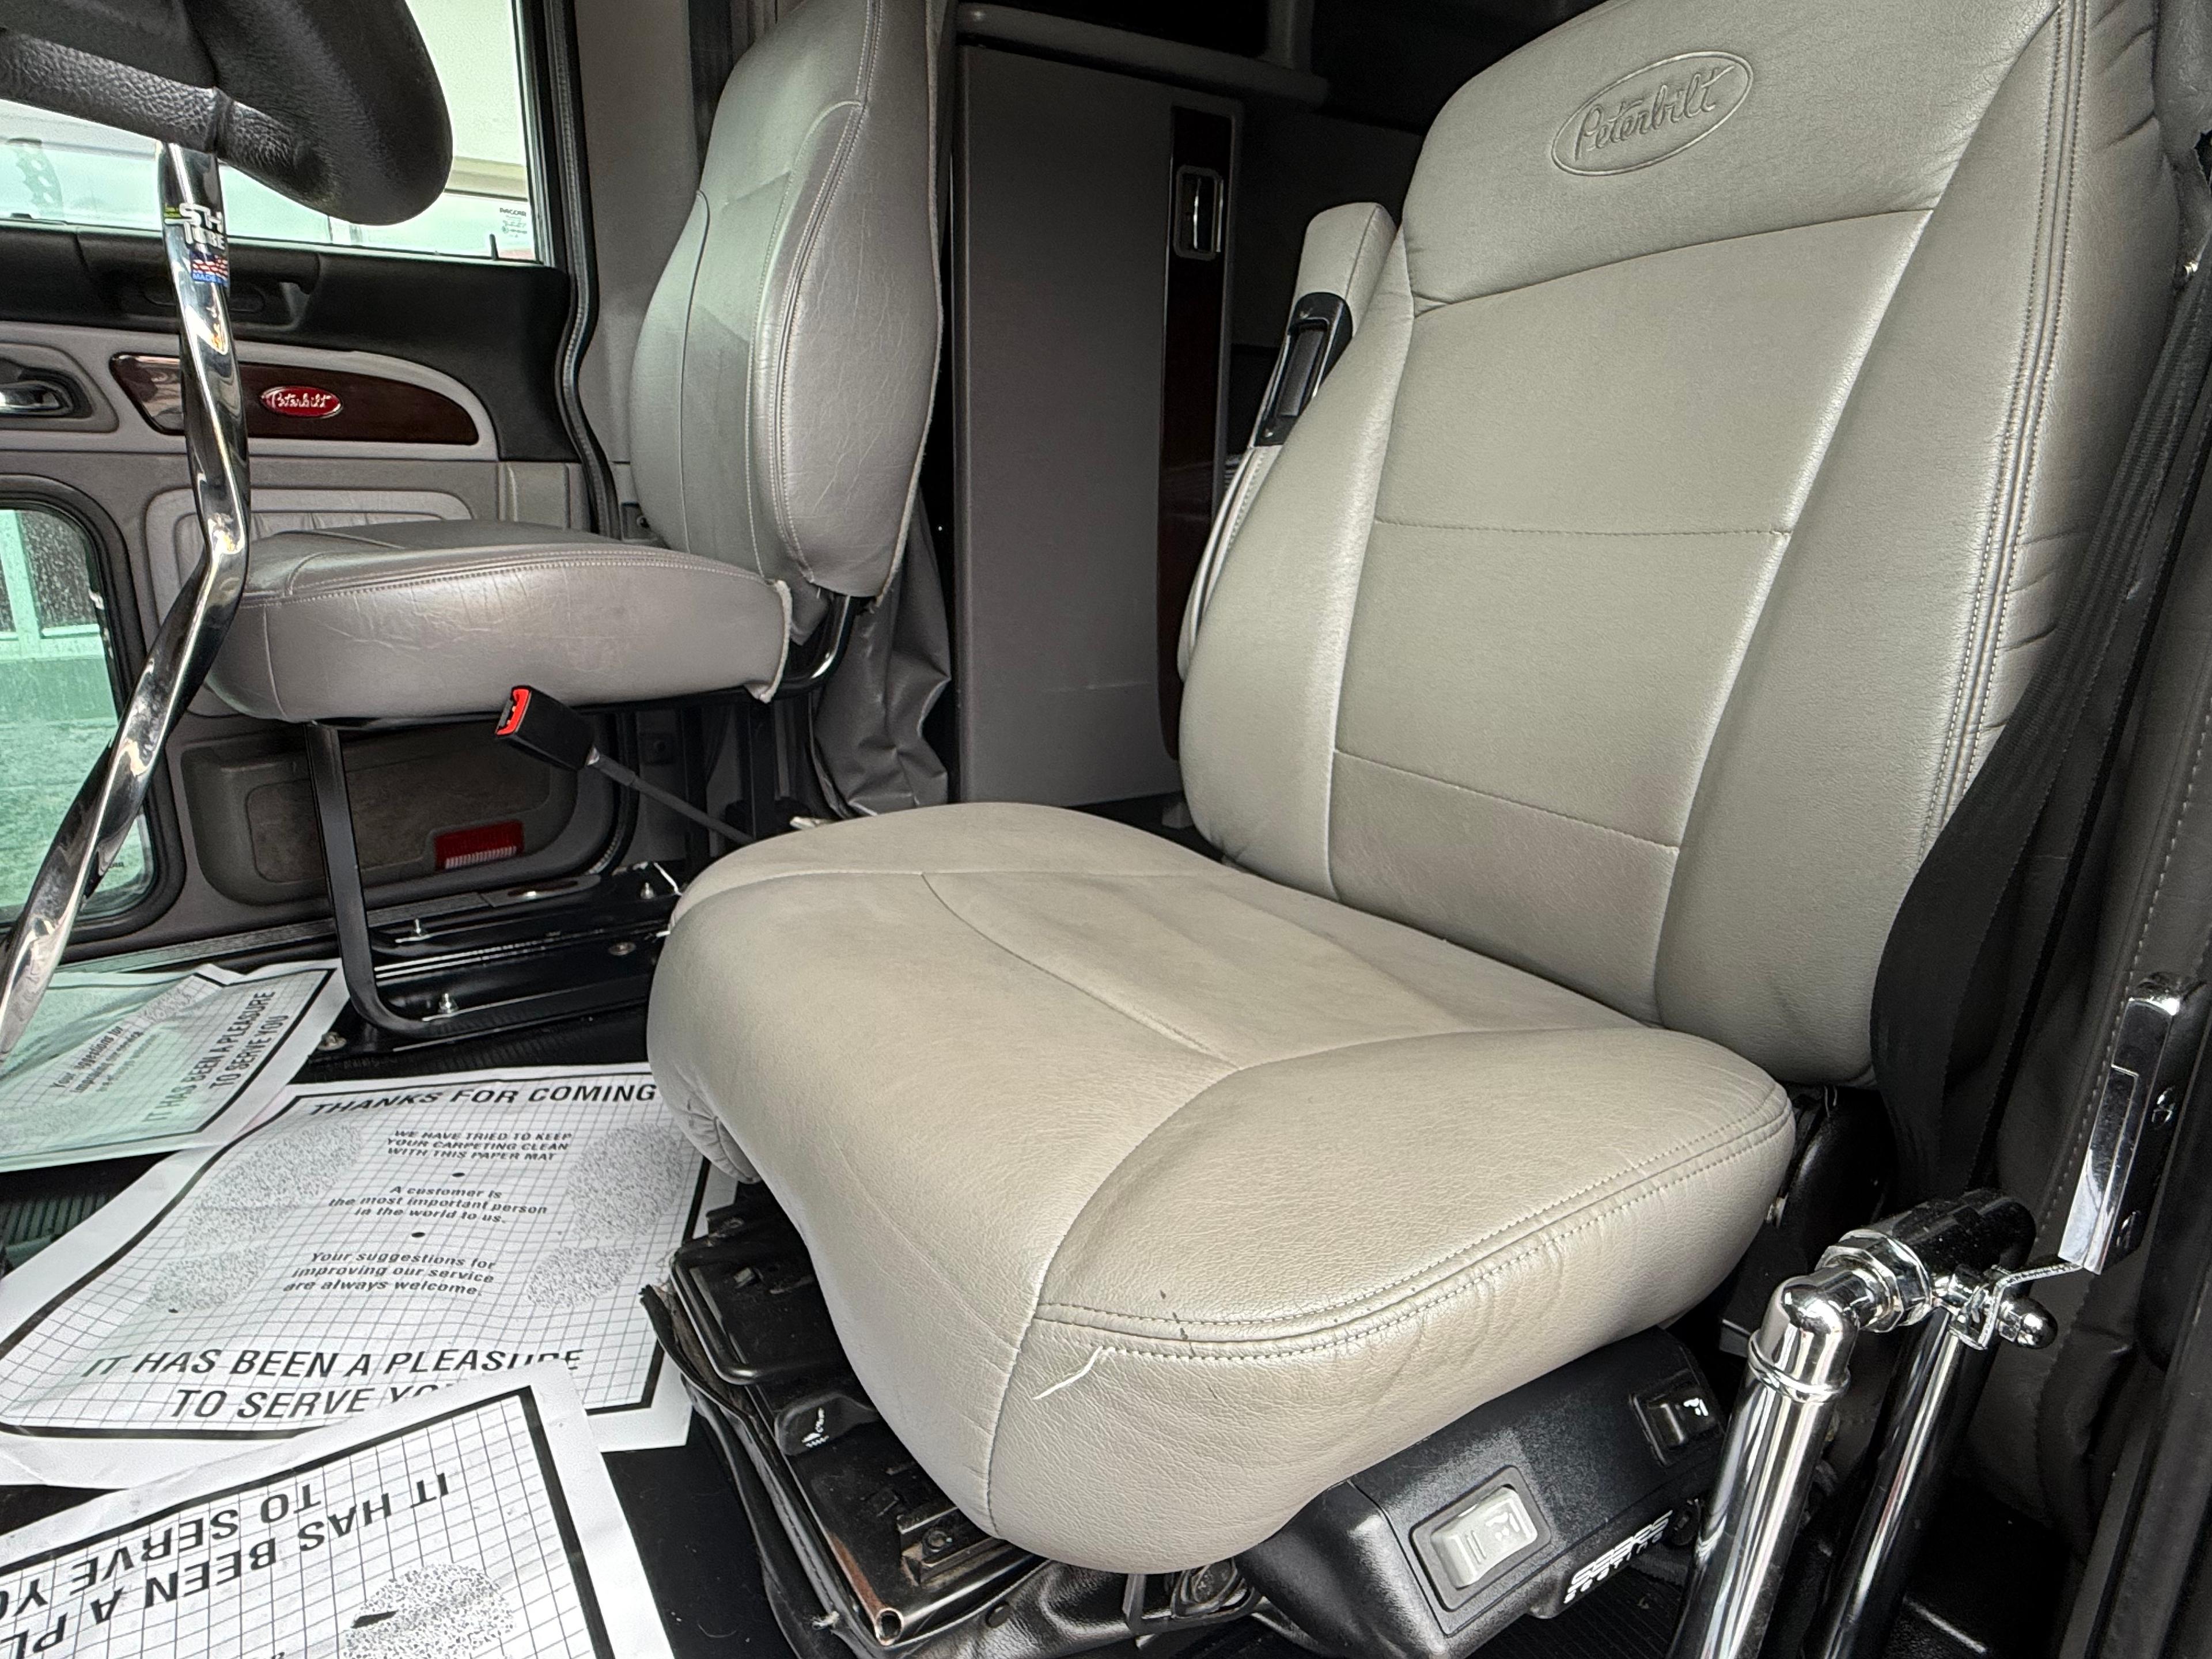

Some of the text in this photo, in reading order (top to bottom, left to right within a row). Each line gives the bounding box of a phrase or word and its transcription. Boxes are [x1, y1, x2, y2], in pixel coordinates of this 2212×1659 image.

[1574, 66, 1735, 161] Peterbilt
[262, 389, 332, 410] Peterbilt
[142, 992, 275, 1122] IT HAS BEEN A PLEASURE
[209, 1016, 289, 1089] TO SERVE YOU
[309, 1084, 657, 1115] THANKS FOR COMING
[388, 1138, 569, 1151] YOUR CARPETING CLEAN
[422, 1132, 461, 1141] HAVE
[465, 1132, 508, 1141] TRIED
[513, 1132, 531, 1141] TO
[535, 1132, 572, 1141] KEEP
[388, 1147, 557, 1161] WITH THIS PAPER MAT
[328, 1197, 548, 1214] the most important person
[389, 1186, 502, 1199] A customer is
[354, 1207, 506, 1224] in the world to us.
[291, 1266, 494, 1283] improving our service
[312, 1252, 496, 1270] Your suggestions for
[283, 1279, 482, 1296] are always welcome.
[81, 1355, 132, 1377] IT
[132, 1349, 222, 1373] HAS
[230, 1350, 338, 1378] BEEN
[346, 1354, 372, 1377] A
[172, 1389, 228, 1418] TO
[237, 1387, 375, 1419] SERVE
[260, 1484, 321, 1523] TO
[410, 1472, 448, 1509] IT
[298, 1493, 392, 1552] HAS
[70, 1509, 238, 1596] SERVE
[144, 1537, 276, 1608] BEEN
[90, 1587, 125, 1625] A
